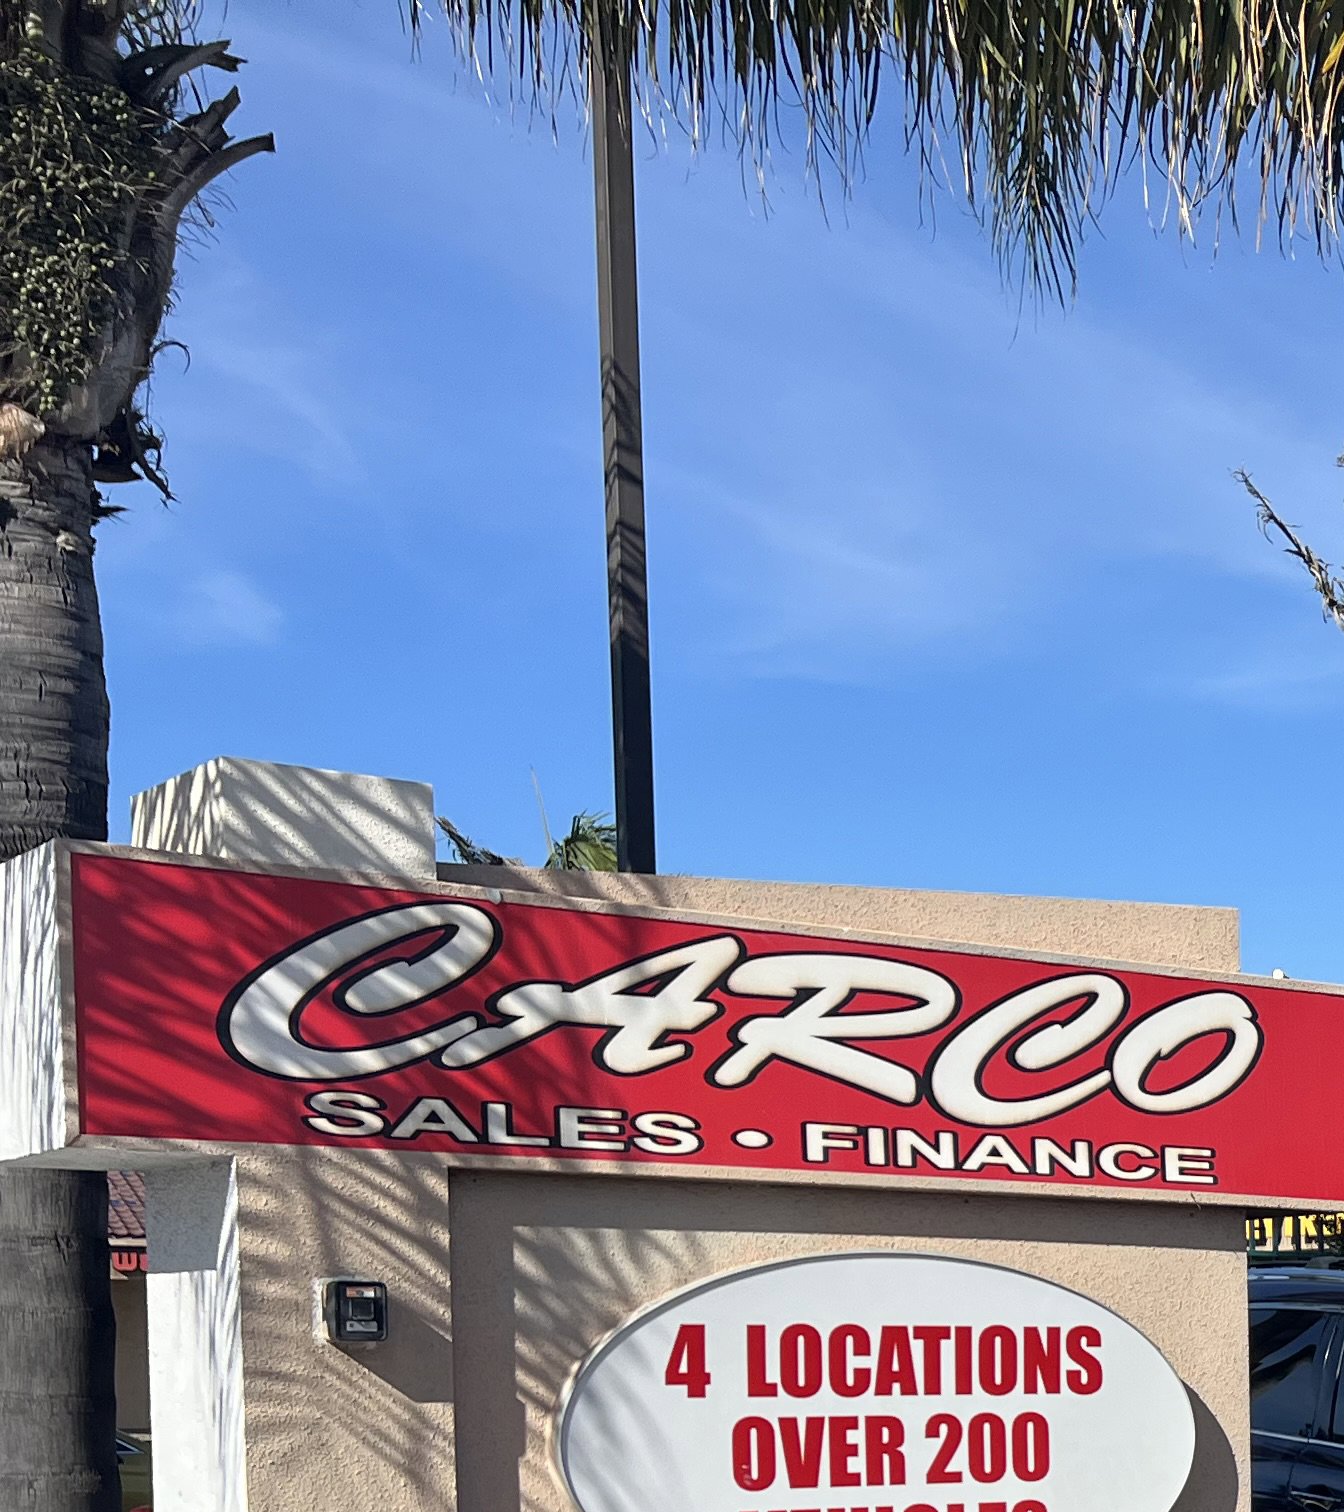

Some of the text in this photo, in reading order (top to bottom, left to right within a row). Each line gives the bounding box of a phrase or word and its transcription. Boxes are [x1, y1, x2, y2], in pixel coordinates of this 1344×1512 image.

[216, 900, 1264, 1128] CARCO
[304, 1091, 1218, 1185] SALES FINANCE
[665, 1323, 1104, 1398] 4 LOCATIONS
[732, 1411, 1050, 1491] OVER 200
